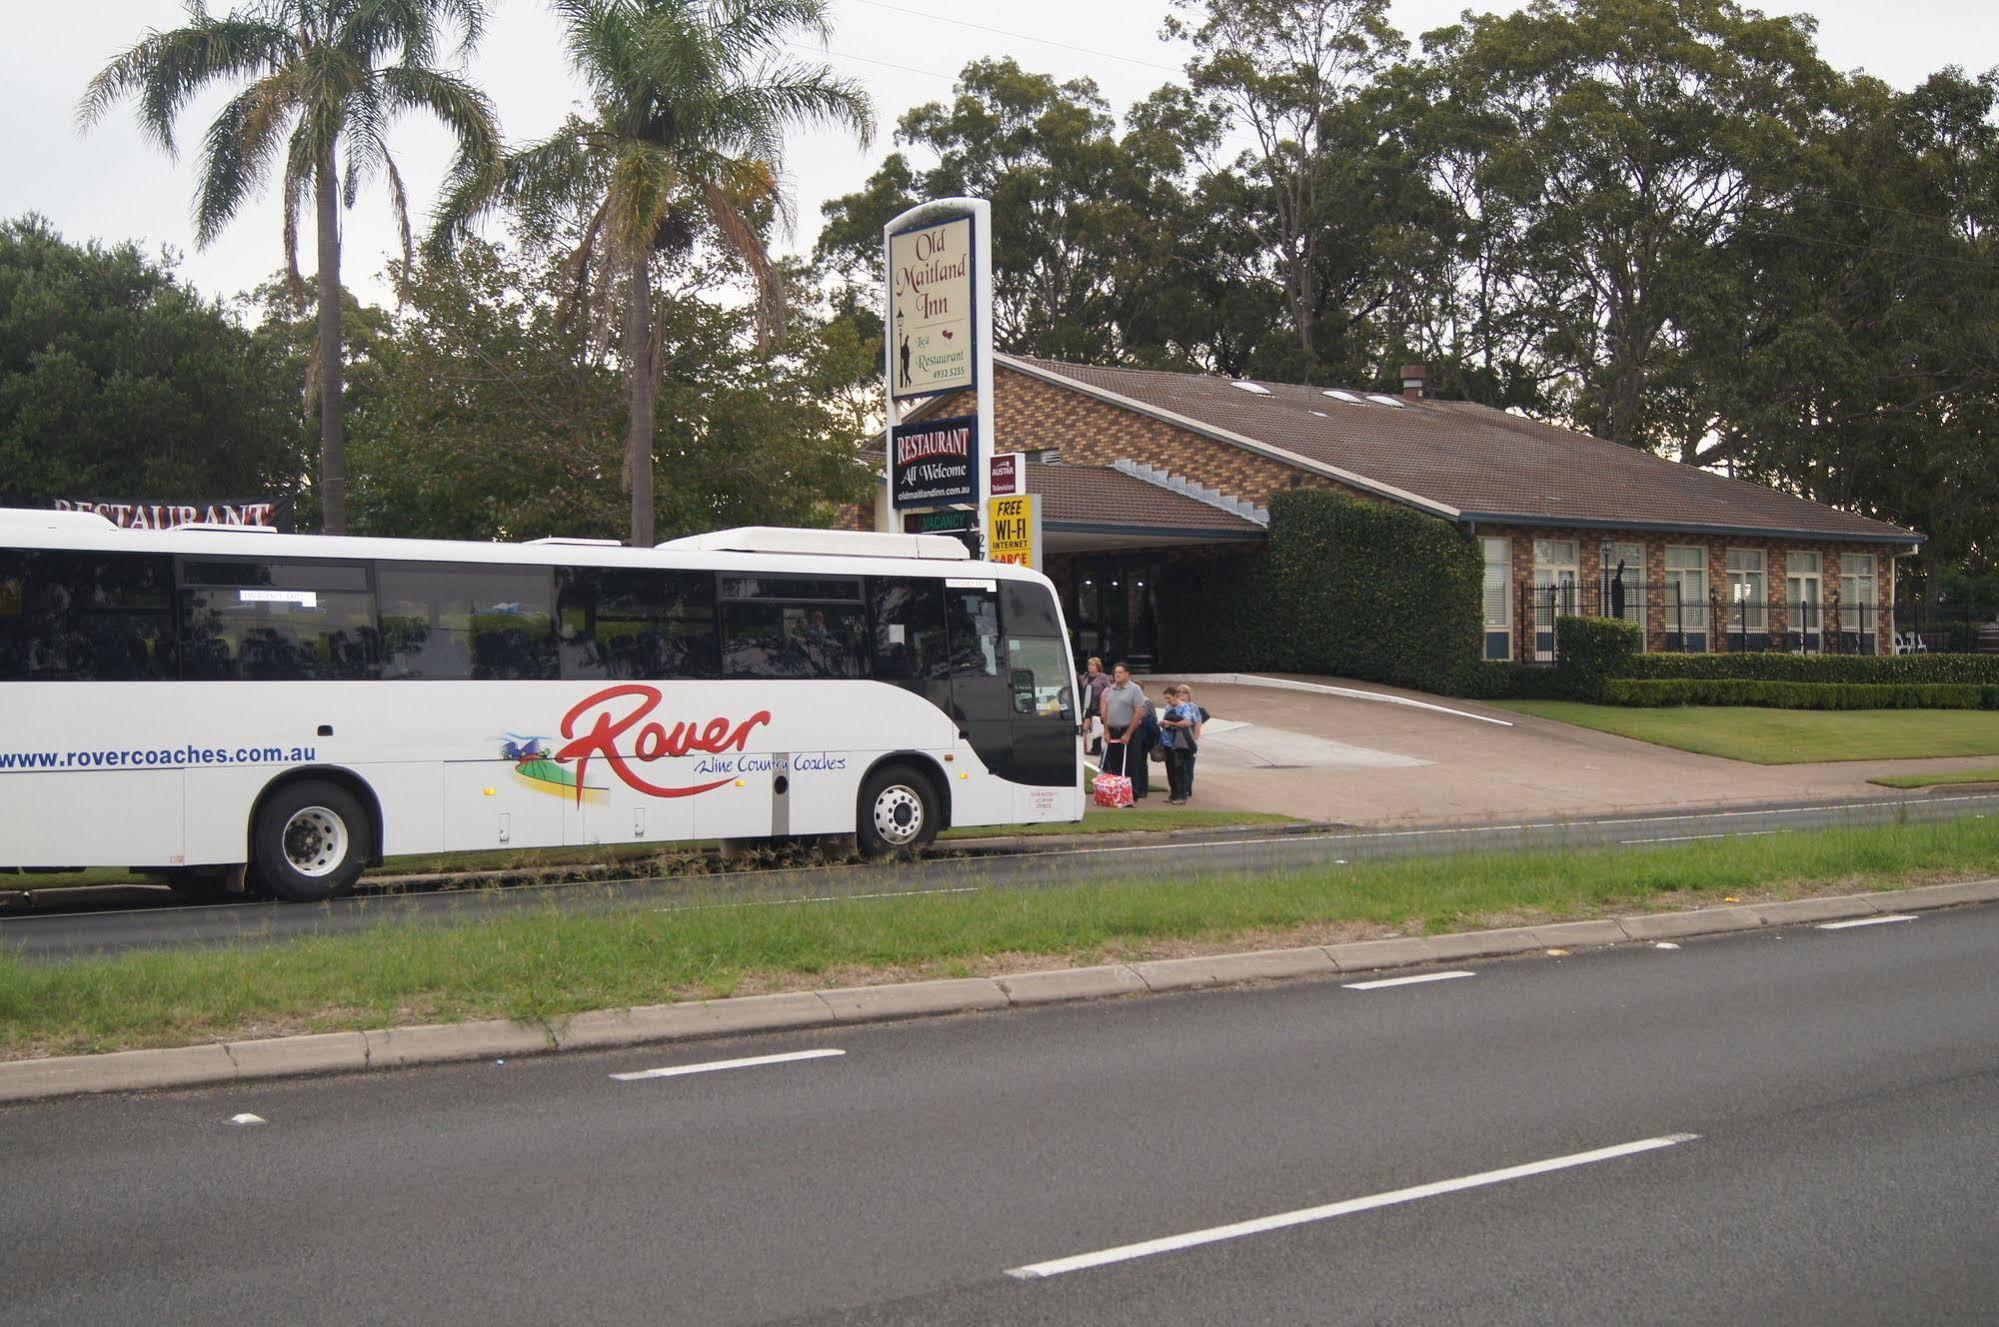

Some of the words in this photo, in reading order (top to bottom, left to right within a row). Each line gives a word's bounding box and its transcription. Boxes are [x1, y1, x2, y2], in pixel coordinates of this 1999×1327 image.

[915, 229, 945, 261] Old
[895, 253, 967, 296] Maitland
[916, 293, 949, 319] Inn
[915, 351, 964, 372] Restaurant
[933, 369, 948, 378] 4932
[897, 428, 970, 465] RESTAURANT
[901, 466, 917, 486] All
[919, 462, 967, 481] Welcome
[991, 466, 1015, 476] AUSTAR
[898, 486, 970, 500] oldmaitlandinn.com.au
[997, 500, 1023, 517] FREE
[923, 512, 966, 529] VACANCY
[995, 518, 1026, 541] WI-FI
[992, 540, 1028, 549] INTERNET
[993, 553, 1027, 565] ARGE
[0, 745, 316, 768] www.rovercoaches.com.au
[555, 684, 771, 811] Rover
[694, 757, 733, 774] Wine
[738, 755, 789, 774] Country
[793, 752, 846, 771] Coaches
